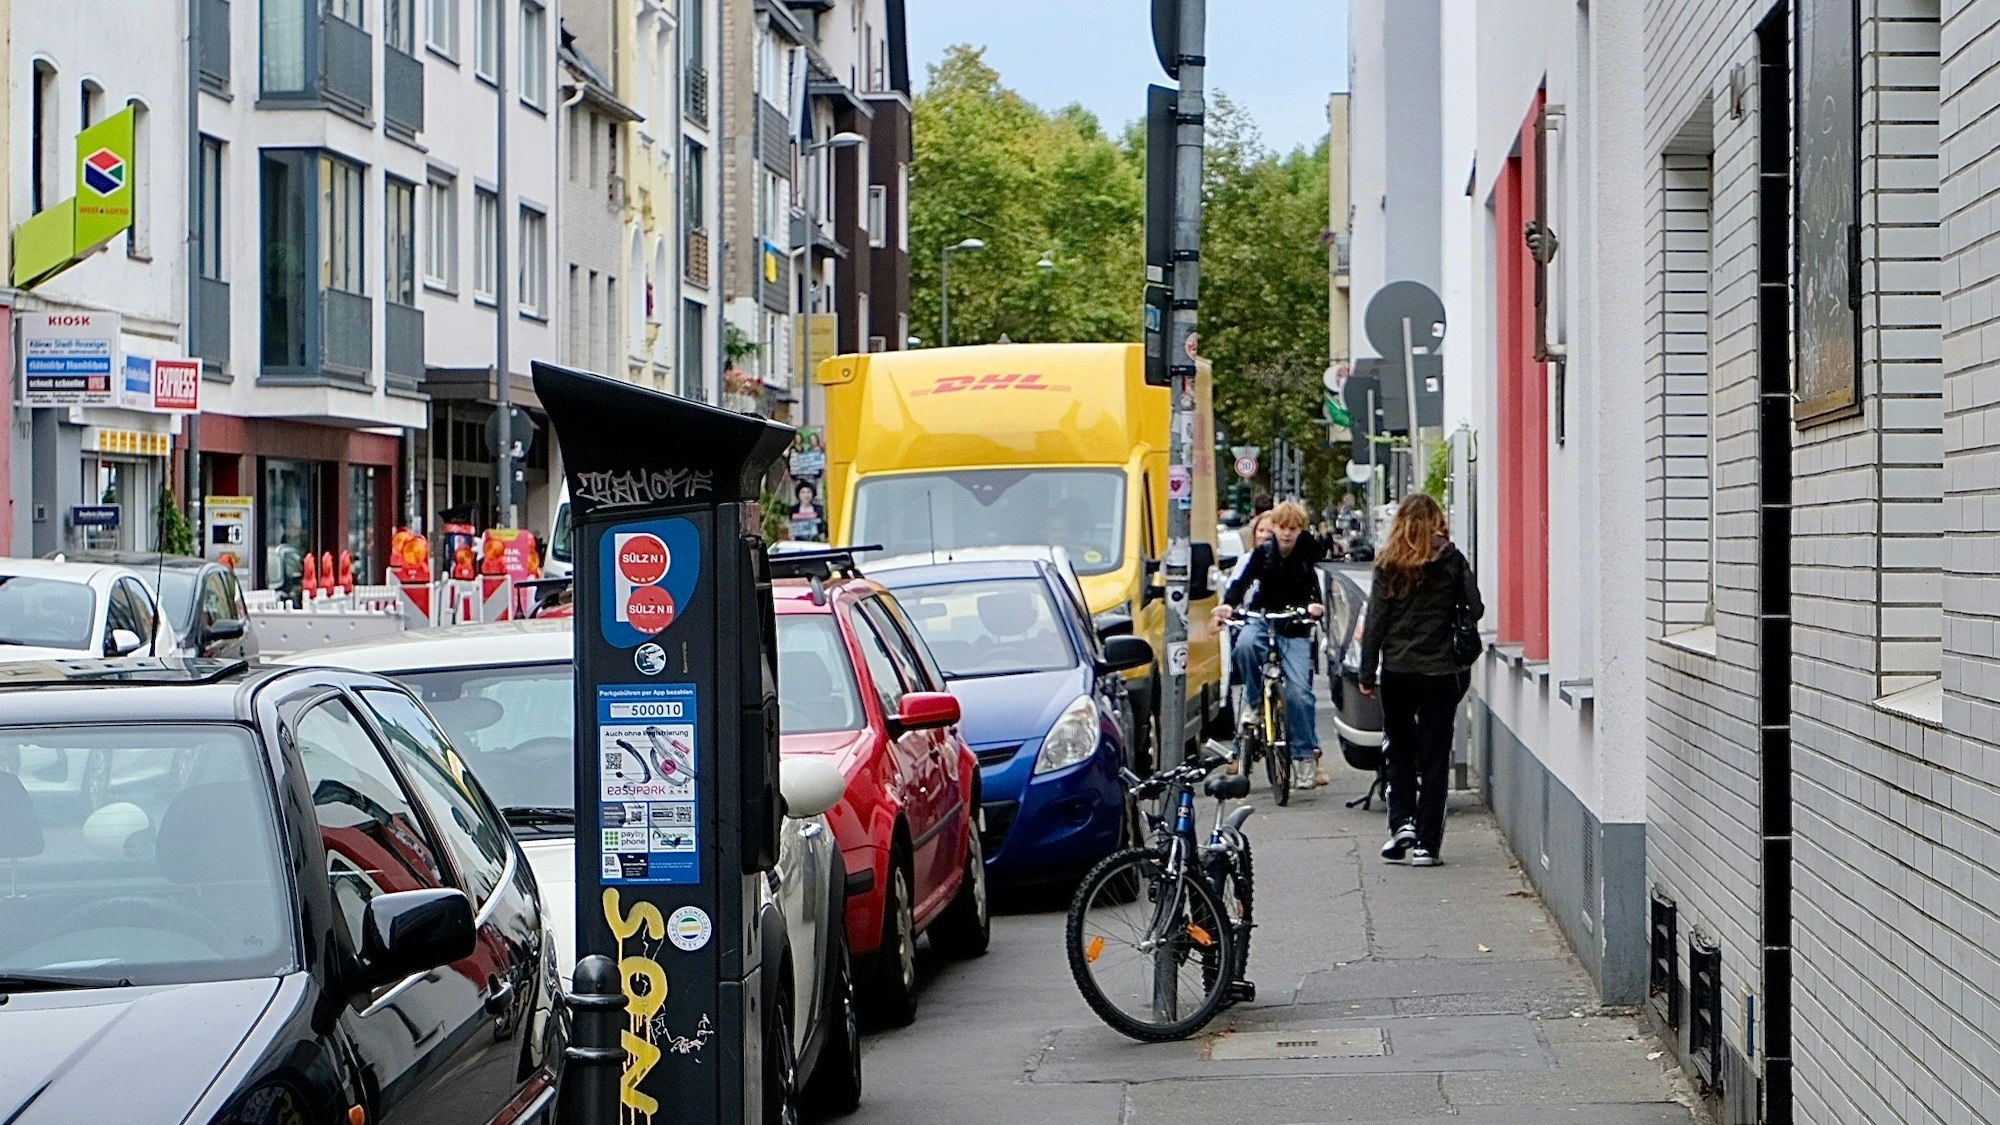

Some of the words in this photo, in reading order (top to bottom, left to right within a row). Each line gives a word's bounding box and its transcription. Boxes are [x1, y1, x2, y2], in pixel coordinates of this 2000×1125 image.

[48, 316, 90, 326] KIOSK
[157, 366, 196, 397] EXPRESS
[932, 373, 1049, 394] DHL
[622, 552, 649, 564] SÜLZ
[650, 553, 659, 564] N
[629, 602, 656, 614] SÜLZ
[657, 604, 665, 614] N
[599, 690, 641, 698] Parkgebühren
[653, 689, 666, 697] App
[666, 688, 693, 696] bezahlen
[631, 704, 681, 716] 500010
[621, 837, 646, 846] phone
